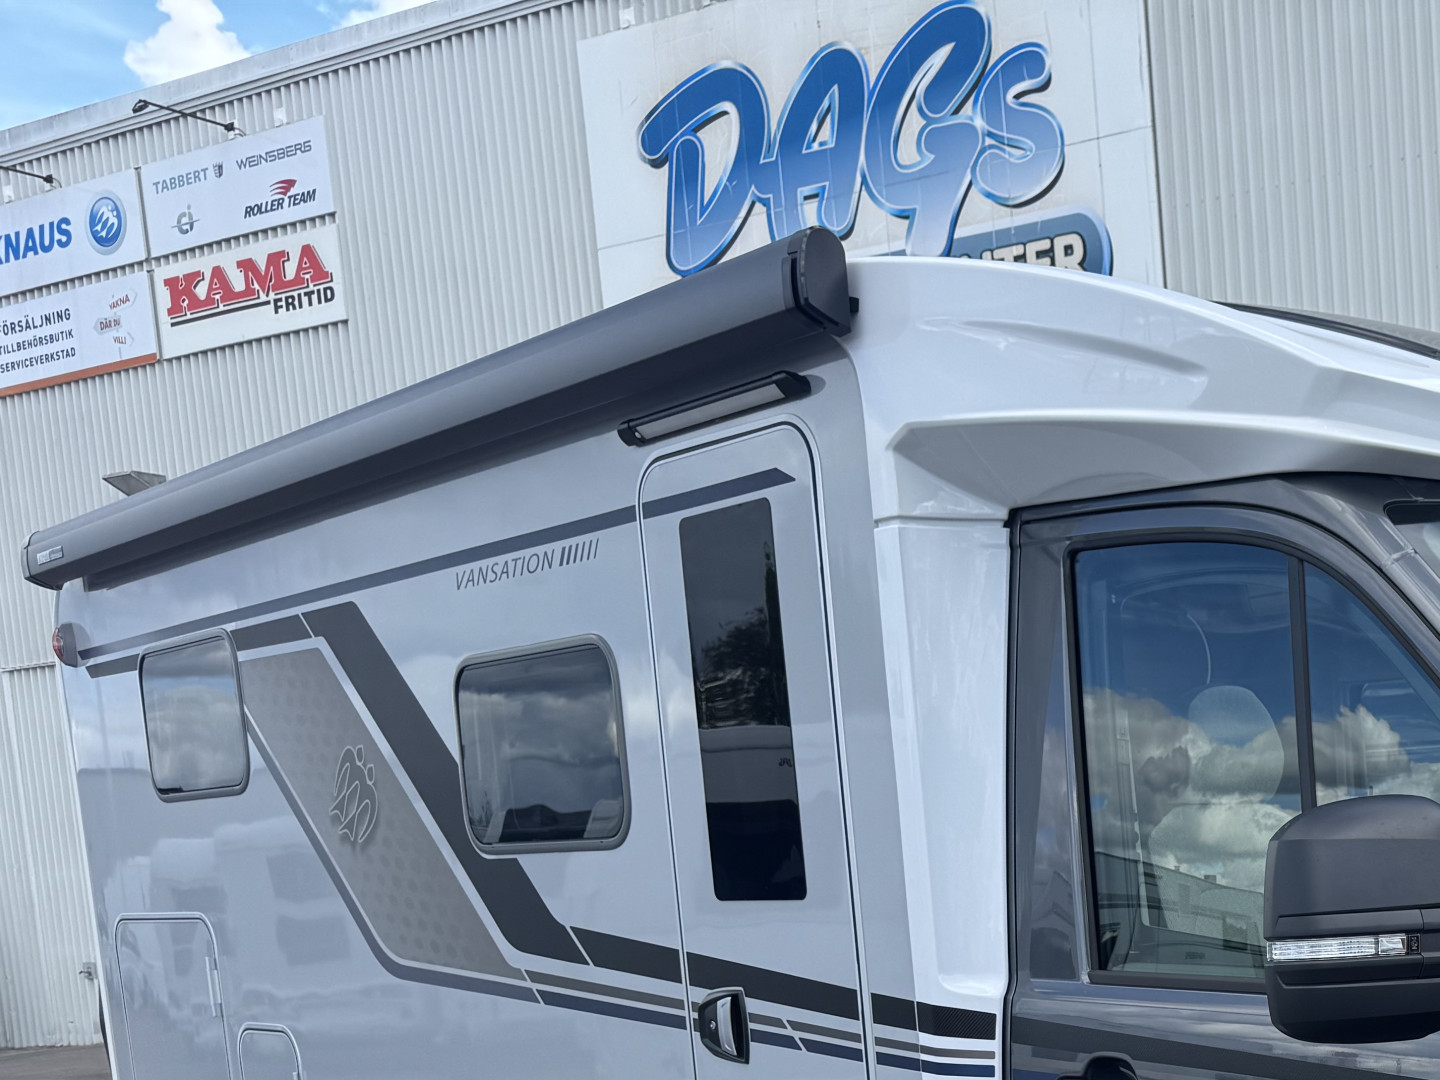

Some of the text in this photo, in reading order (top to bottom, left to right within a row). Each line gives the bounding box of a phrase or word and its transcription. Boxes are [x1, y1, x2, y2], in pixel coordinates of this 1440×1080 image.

[236, 140, 312, 170] WEINSBERG
[153, 168, 209, 194] TABBERT
[244, 189, 317, 219] ROLLER TEAM
[163, 244, 332, 319] KAMA
[273, 286, 335, 314] FRITID
[0, 308, 71, 336] ÖRSÄLJNING
[0, 347, 76, 373] SERVICEVERKSTAD
[455, 549, 555, 590] VANSATION
